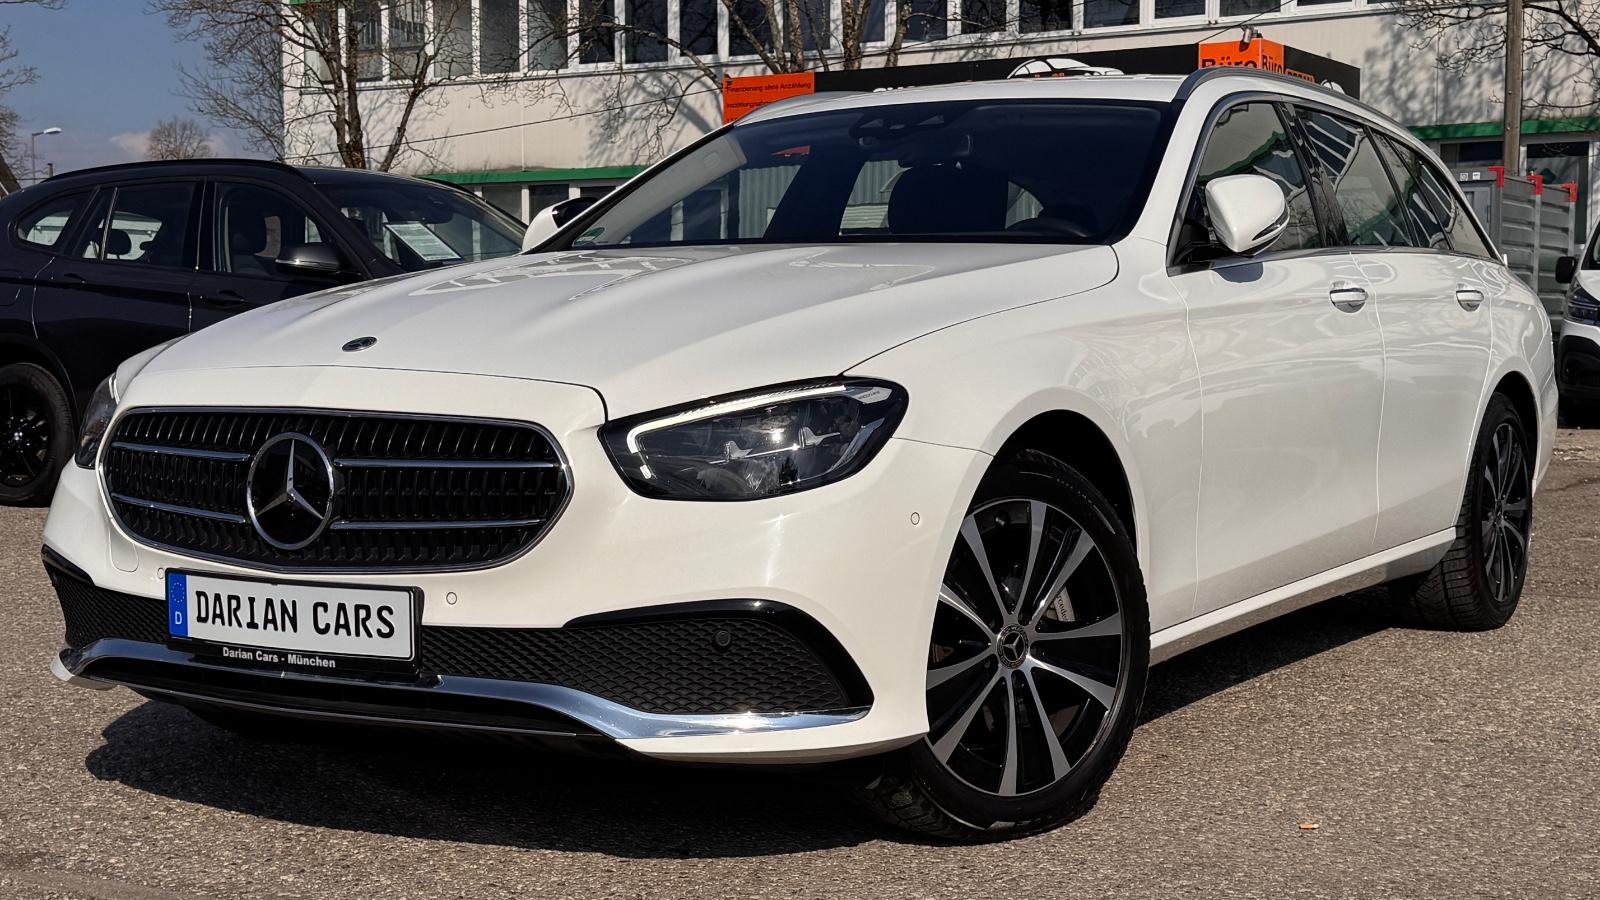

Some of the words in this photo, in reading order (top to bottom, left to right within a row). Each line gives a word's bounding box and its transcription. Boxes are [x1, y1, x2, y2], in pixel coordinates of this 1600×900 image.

[1201, 56, 1257, 68] Büo
[780, 82, 812, 90] Anzahlung
[175, 611, 183, 625] D
[195, 590, 298, 633] DARIAN
[312, 601, 395, 639] CARS
[222, 646, 253, 660] Darian
[255, 651, 279, 663] Cars
[287, 653, 336, 668] München
